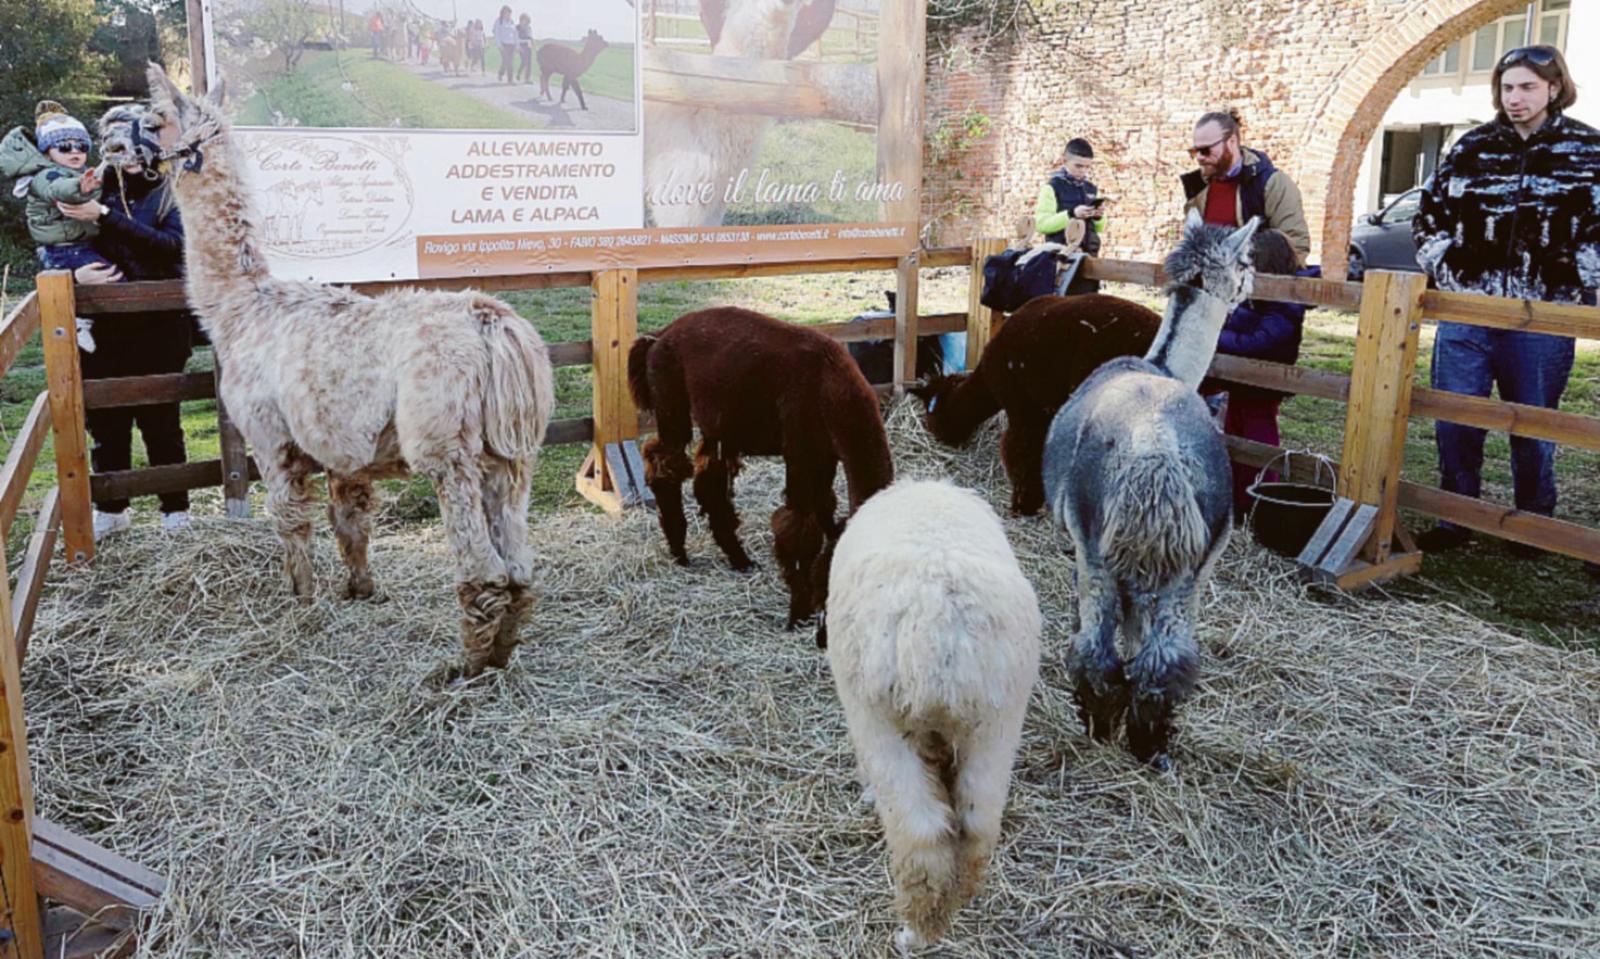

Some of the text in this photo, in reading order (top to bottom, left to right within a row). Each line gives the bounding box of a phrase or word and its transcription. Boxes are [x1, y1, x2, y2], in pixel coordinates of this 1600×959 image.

[467, 141, 603, 157] ALLEVAMENTO
[446, 163, 615, 179] ADDESTRAMENTO
[481, 185, 578, 201] E VENDITA
[648, 168, 906, 206] dove il lama ti ama
[451, 206, 600, 224] LAMA E ALPACA
[424, 241, 460, 256] Rovigo
[463, 240, 477, 254] via
[479, 239, 515, 254] Ippolito
